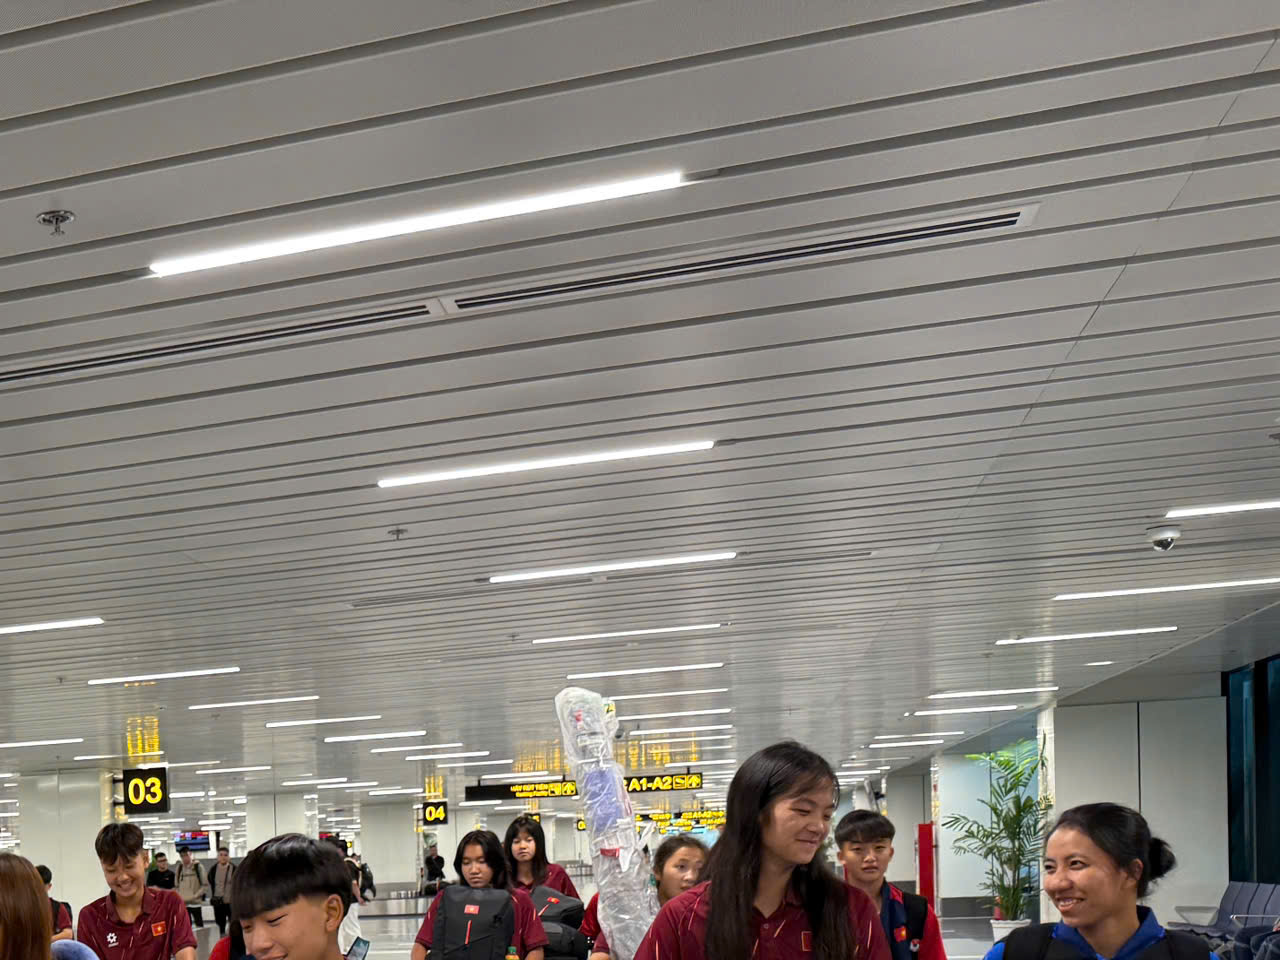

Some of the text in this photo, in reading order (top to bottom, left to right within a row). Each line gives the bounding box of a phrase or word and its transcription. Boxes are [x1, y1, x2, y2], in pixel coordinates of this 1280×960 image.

[128, 777, 162, 805] 03
[628, 775, 673, 792] A1-A2
[425, 805, 445, 821] 04
